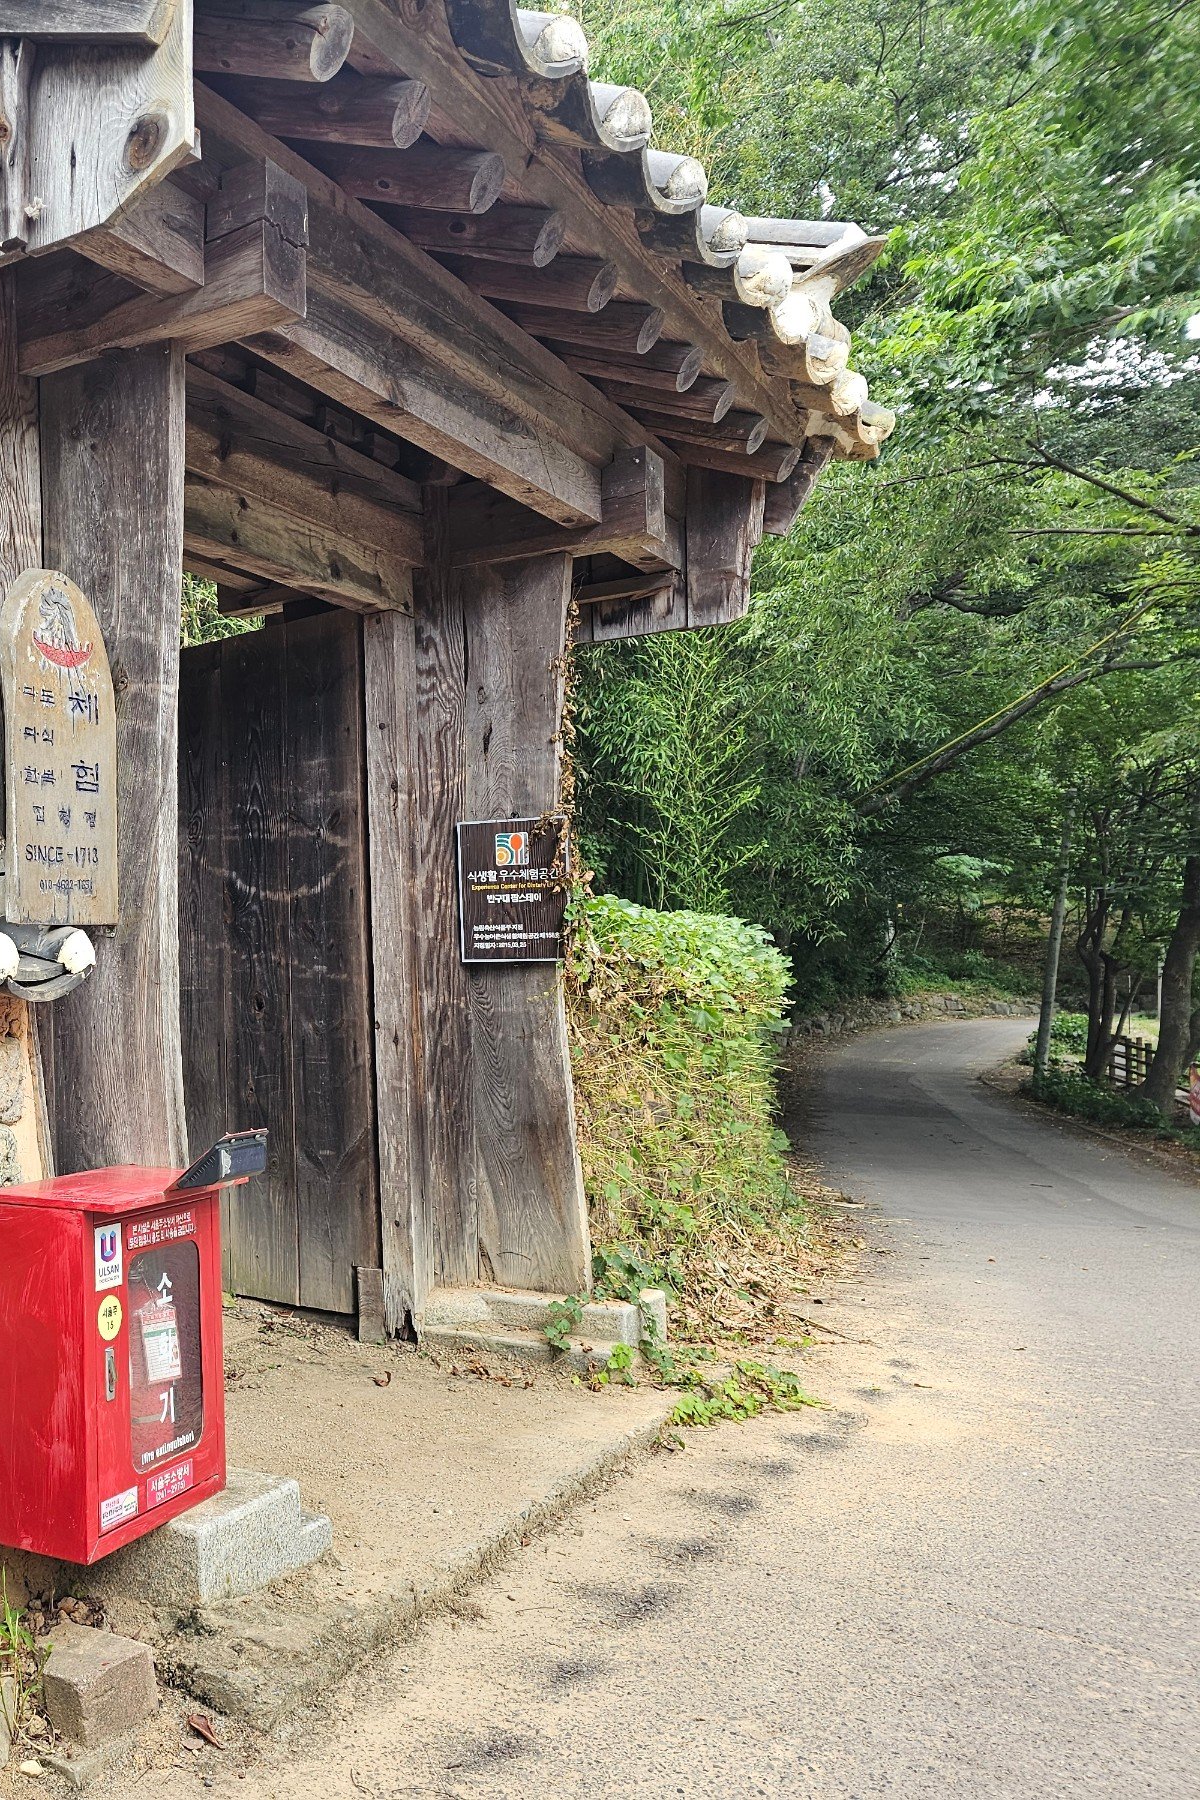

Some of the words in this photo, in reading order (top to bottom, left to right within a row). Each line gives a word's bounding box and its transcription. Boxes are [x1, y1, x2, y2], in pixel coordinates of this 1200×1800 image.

[25, 844, 64, 863] SINCE
[467, 870, 498, 882] 식생활
[486, 894, 510, 904] 반구대
[510, 892, 542, 903] 팜스테이
[98, 1263, 120, 1278] ULSAN
[102, 1305, 118, 1318] 서울주
[106, 1321, 114, 1330] 15
[156, 1272, 176, 1424] 소화기
[151, 1464, 190, 1492] 서울주소방서
